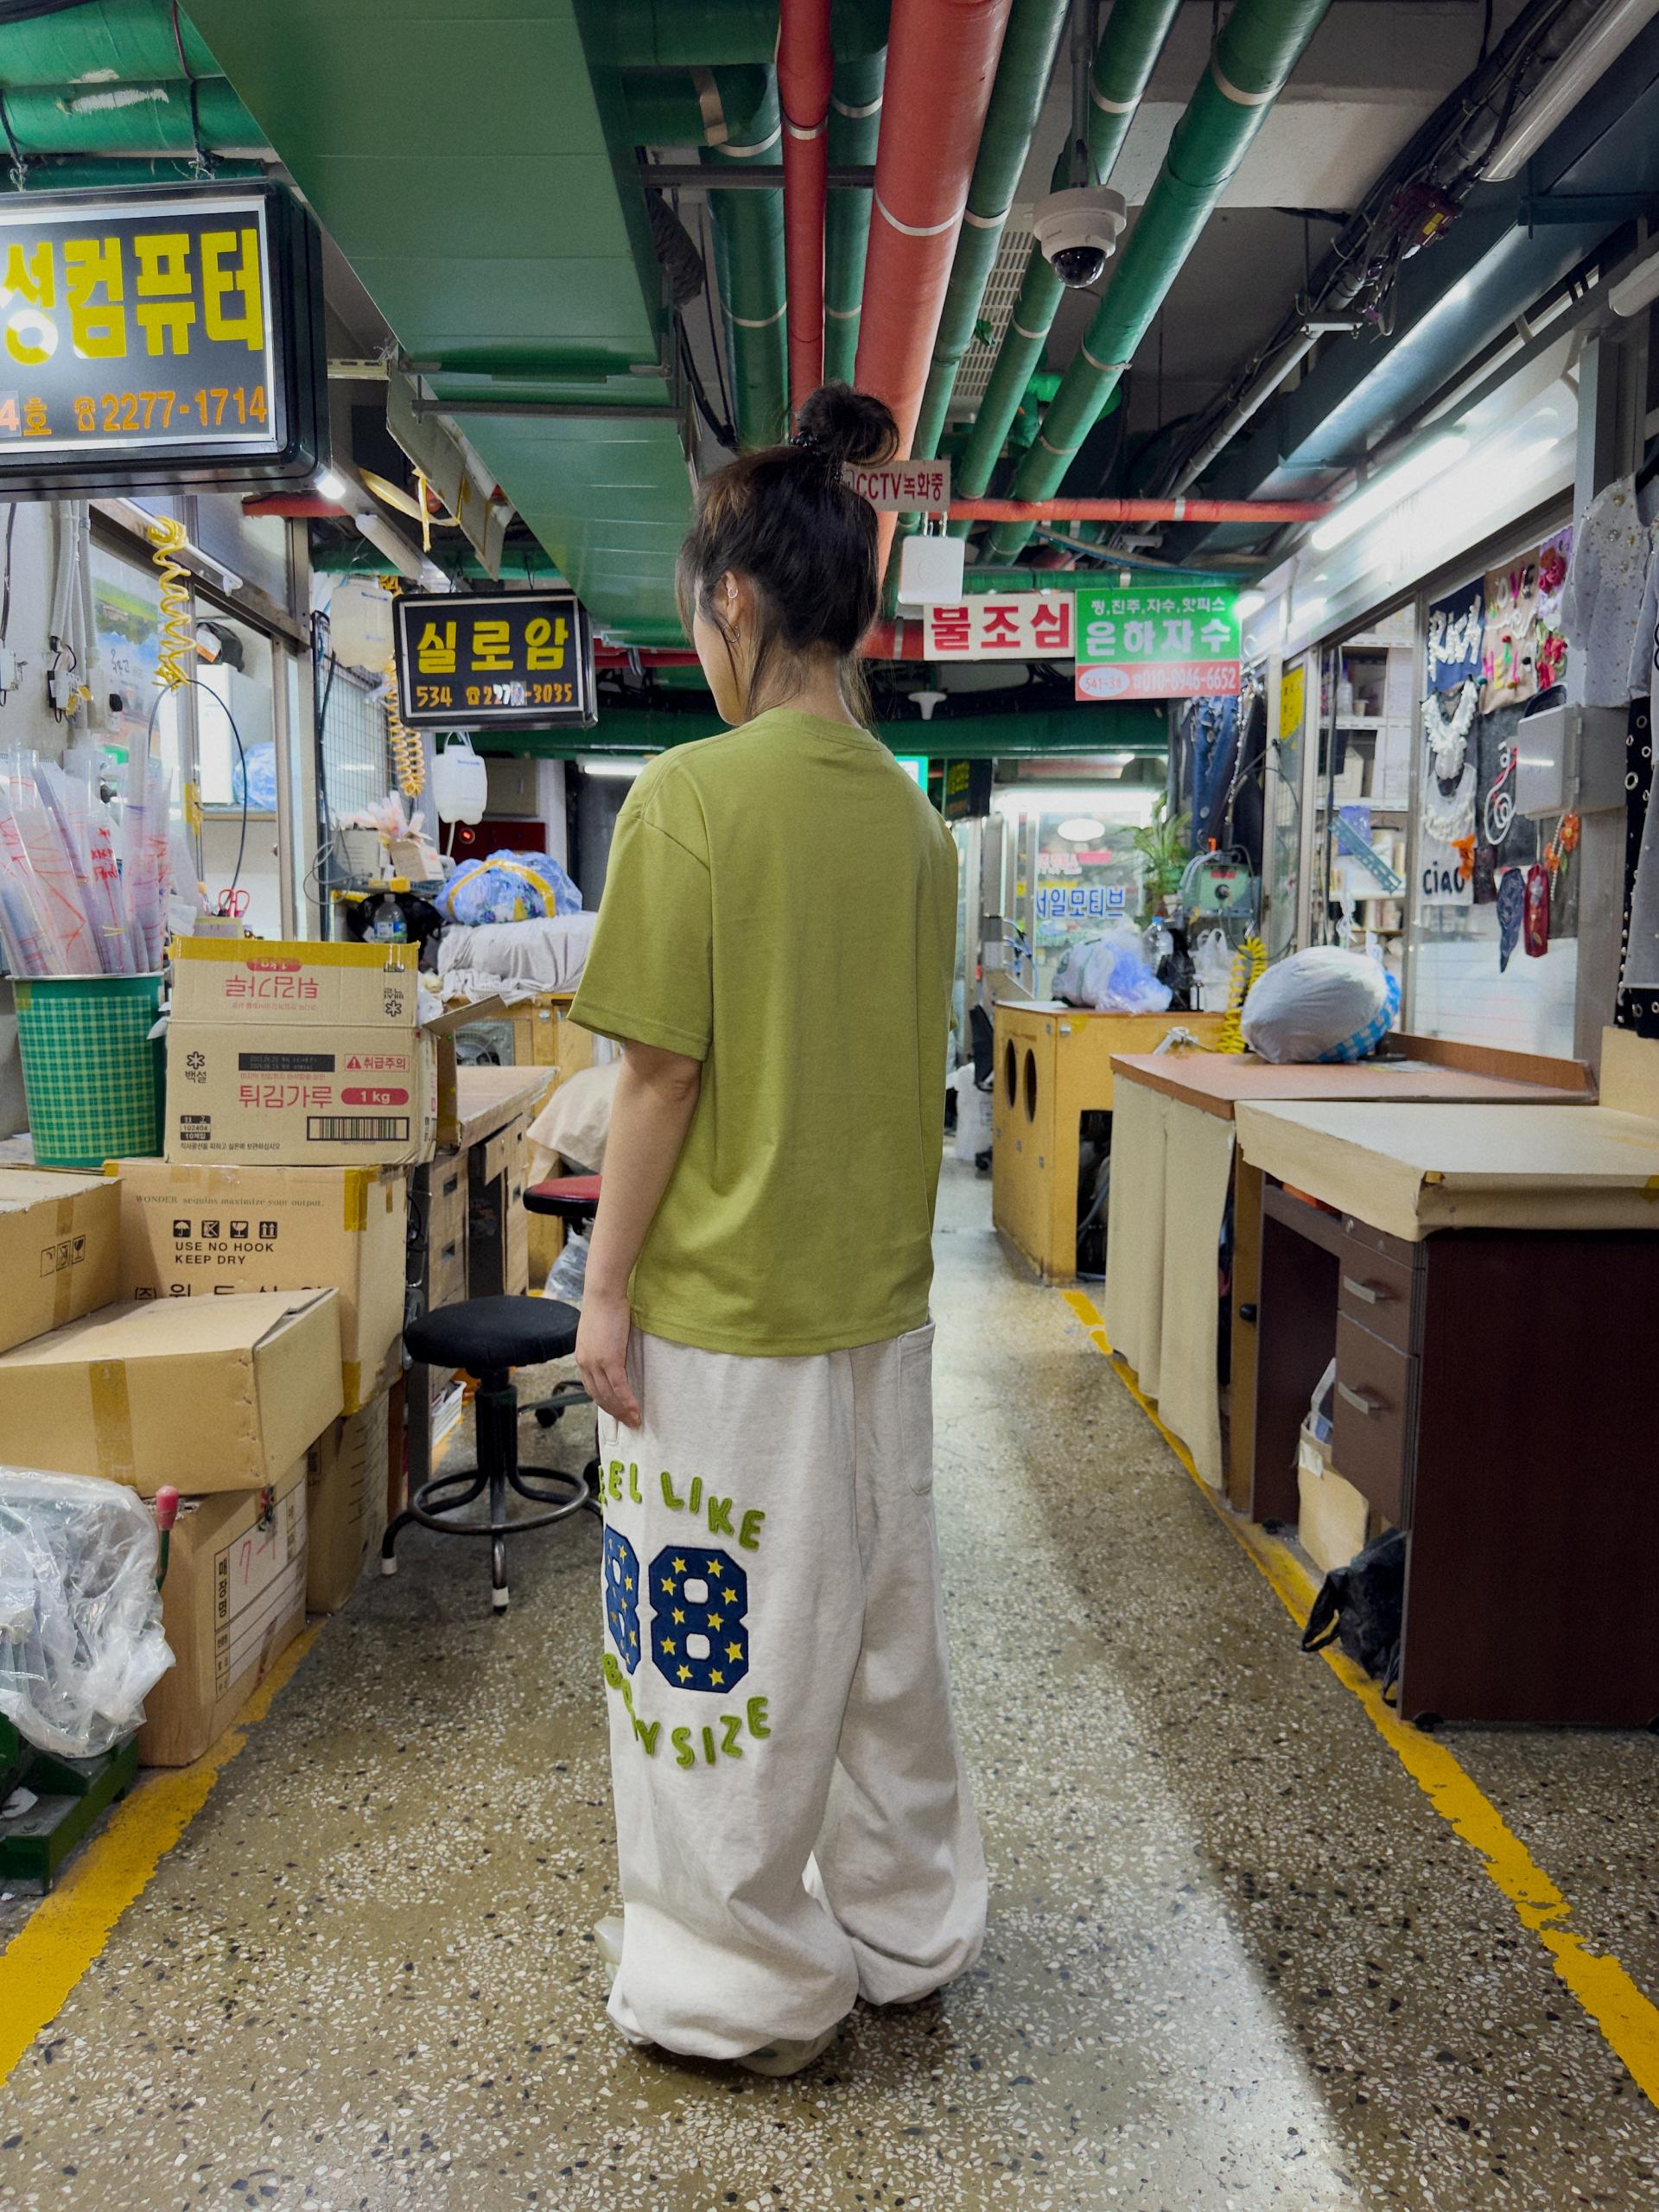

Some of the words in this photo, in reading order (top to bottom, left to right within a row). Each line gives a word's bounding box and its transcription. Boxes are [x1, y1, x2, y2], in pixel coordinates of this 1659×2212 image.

[101, 386, 267, 432] 2277-1714
[931, 603, 1070, 651] 불조심
[1086, 618, 1231, 657] 은하자수
[416, 617, 569, 674] 실로암
[416, 684, 453, 707] 534
[226, 975, 319, 999] 튀김가루
[363, 1057, 407, 1070] 취급주의
[185, 1071, 207, 1084] 백설
[238, 1084, 333, 1109] 튀김가루
[360, 1090, 368, 1102] 1
[372, 1090, 391, 1104] kg
[136, 1195, 178, 1204] WONDER
[175, 1242, 202, 1252] USE
[208, 1243, 228, 1252] NO
[233, 1243, 275, 1253] HOOK
[175, 1255, 212, 1265] KEEP
[217, 1255, 246, 1265] DRY
[660, 1471, 766, 1550] LIKE
